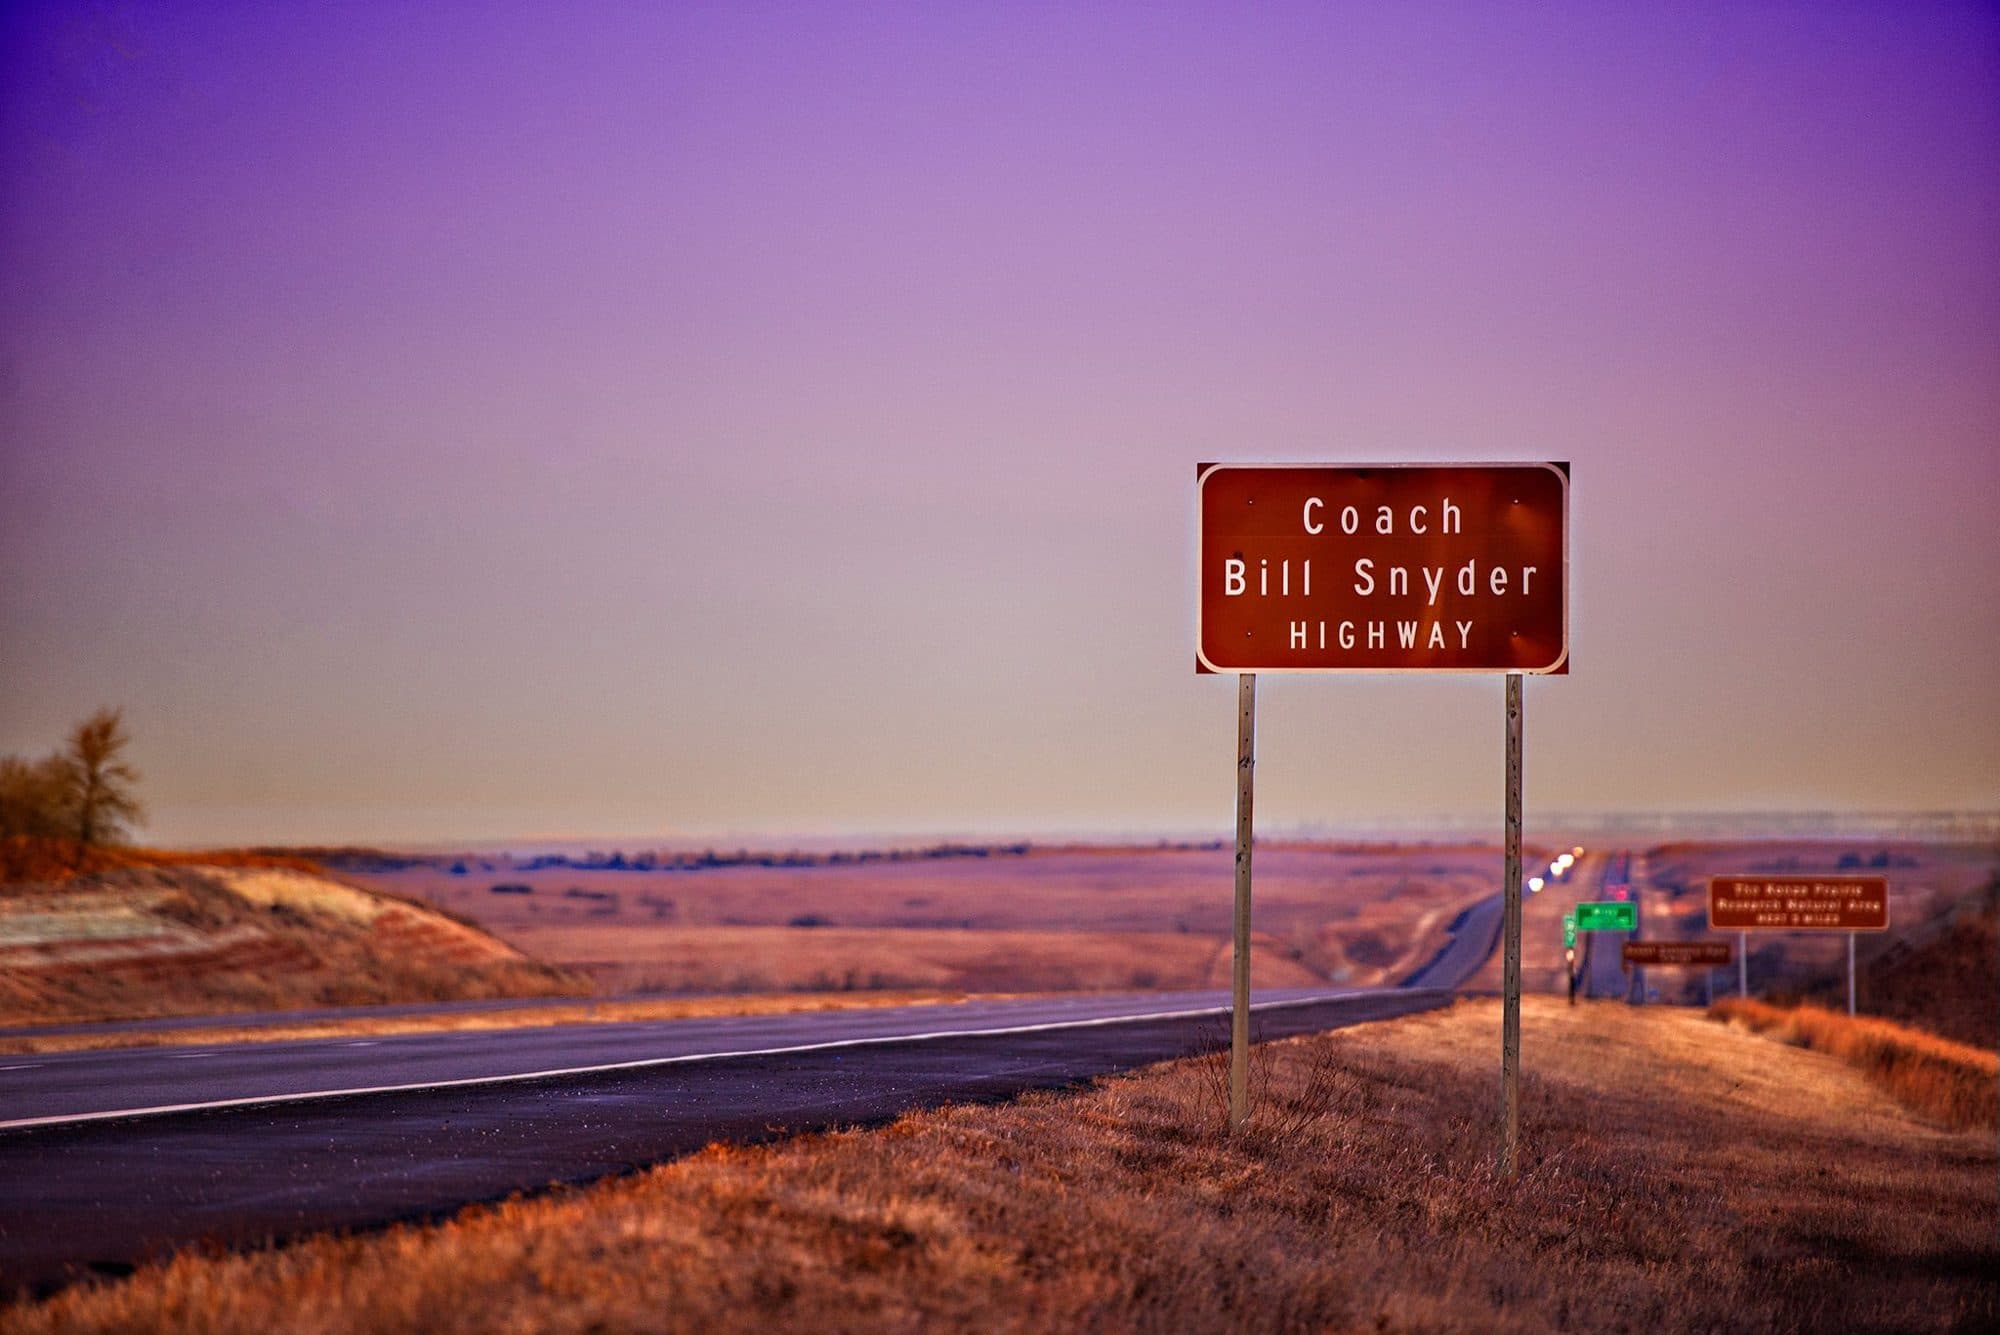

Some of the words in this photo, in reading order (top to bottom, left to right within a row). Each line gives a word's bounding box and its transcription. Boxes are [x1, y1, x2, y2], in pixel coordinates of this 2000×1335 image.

[1303, 497, 1461, 535] Coach
[1225, 558, 1310, 596] Bill
[1354, 558, 1537, 606] Snyder
[1290, 621, 1473, 649] HIGHWAY
[1734, 883, 1760, 897] The
[1716, 898, 1781, 912] Research
[1786, 899, 1842, 912] Natural
[1847, 899, 1881, 912] Area
